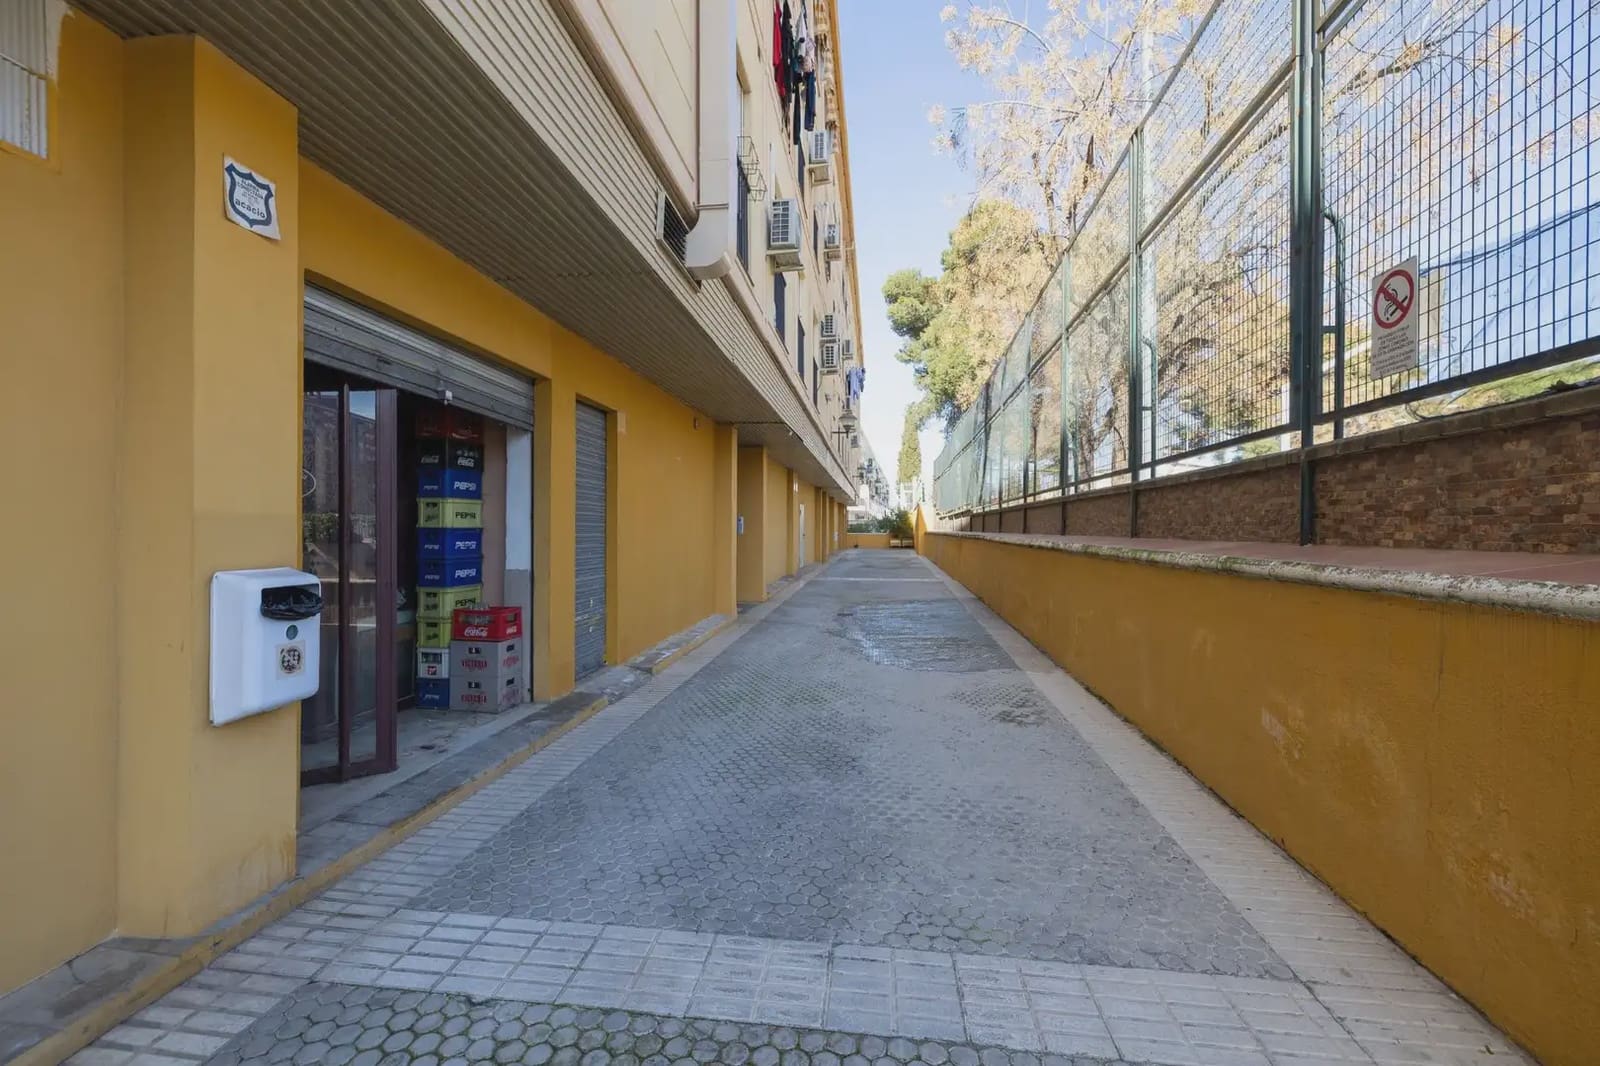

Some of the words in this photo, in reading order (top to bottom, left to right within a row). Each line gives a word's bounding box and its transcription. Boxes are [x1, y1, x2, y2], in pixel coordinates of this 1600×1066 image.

[235, 198, 266, 219] acacio
[454, 481, 477, 491] PEPSI
[455, 511, 476, 520] PEPSI
[455, 541, 477, 550] PEPSI
[455, 568, 477, 579] PEPSI
